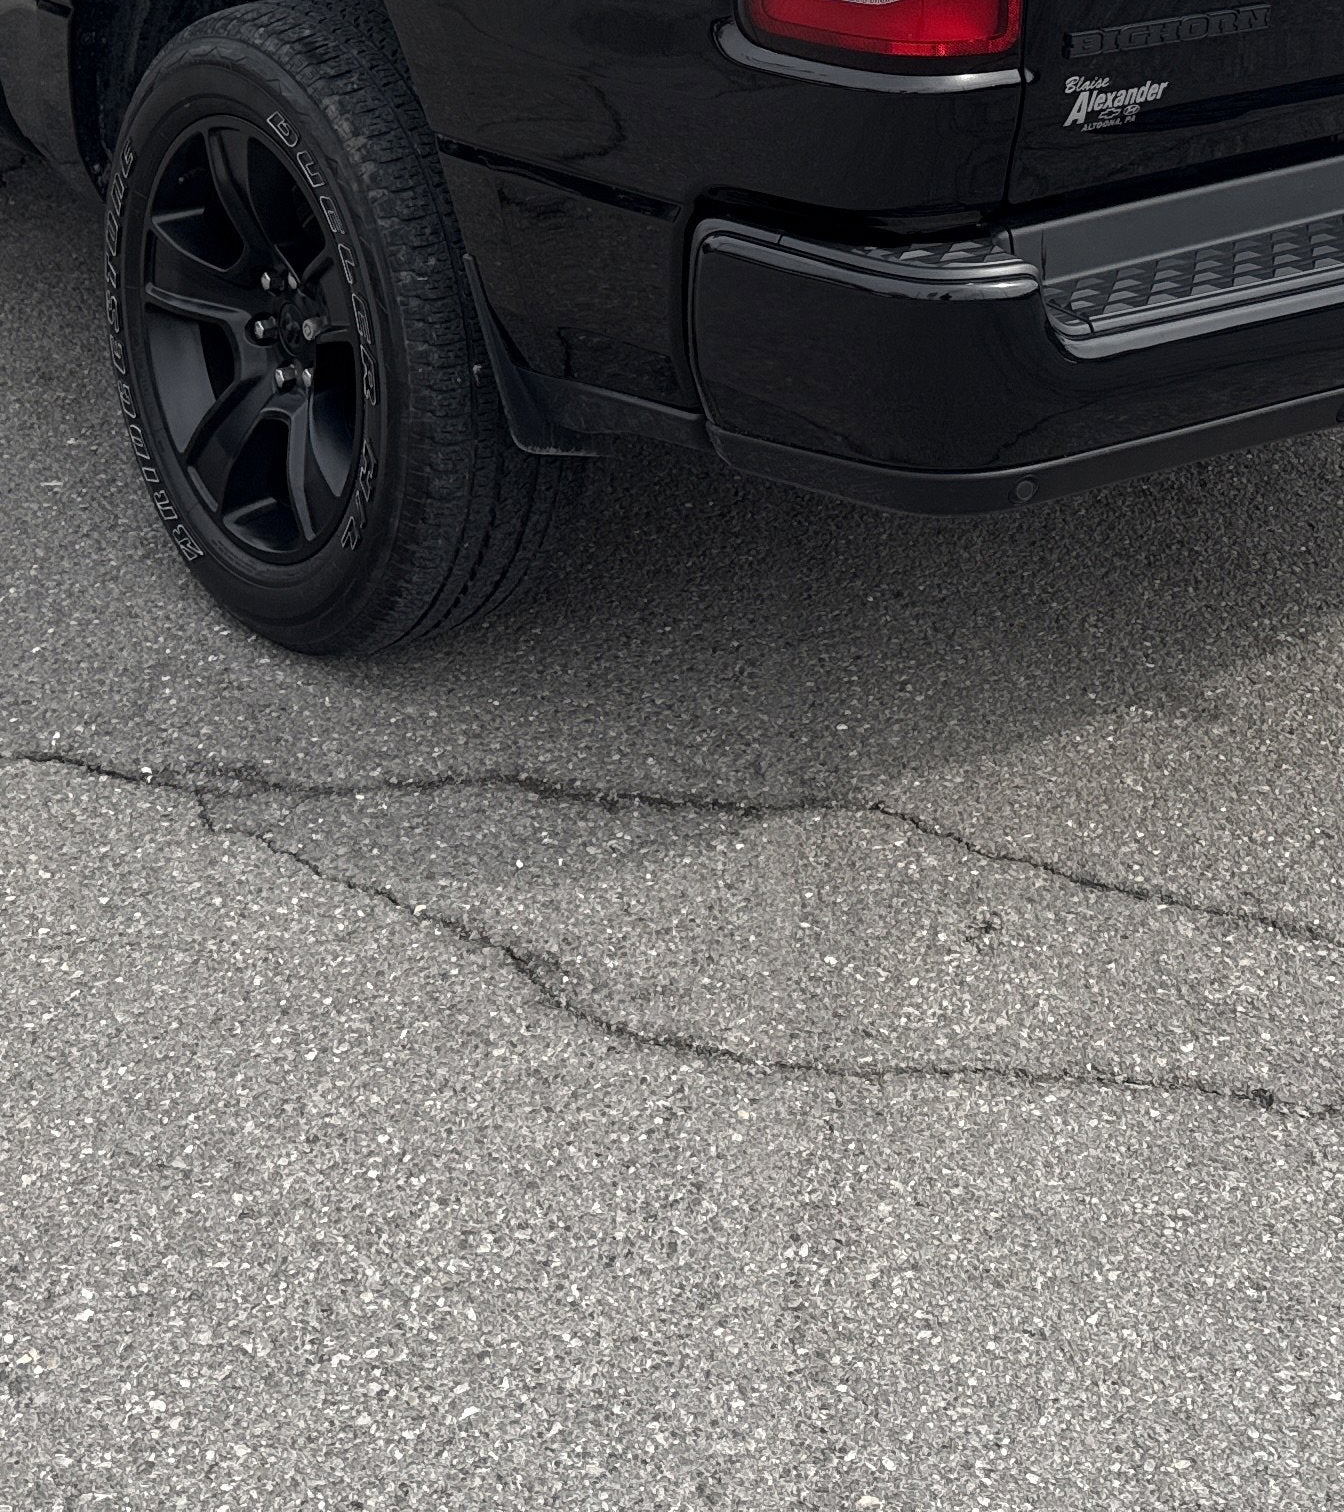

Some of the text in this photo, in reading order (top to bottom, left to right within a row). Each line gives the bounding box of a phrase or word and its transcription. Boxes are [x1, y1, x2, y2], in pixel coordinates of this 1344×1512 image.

[1063, 80, 1170, 127] Alexander
[1064, 75, 1110, 94] Blaise
[1124, 115, 1136, 124] PA
[267, 112, 378, 406] DUELER
[104, 139, 204, 563] BRIDGESTONE
